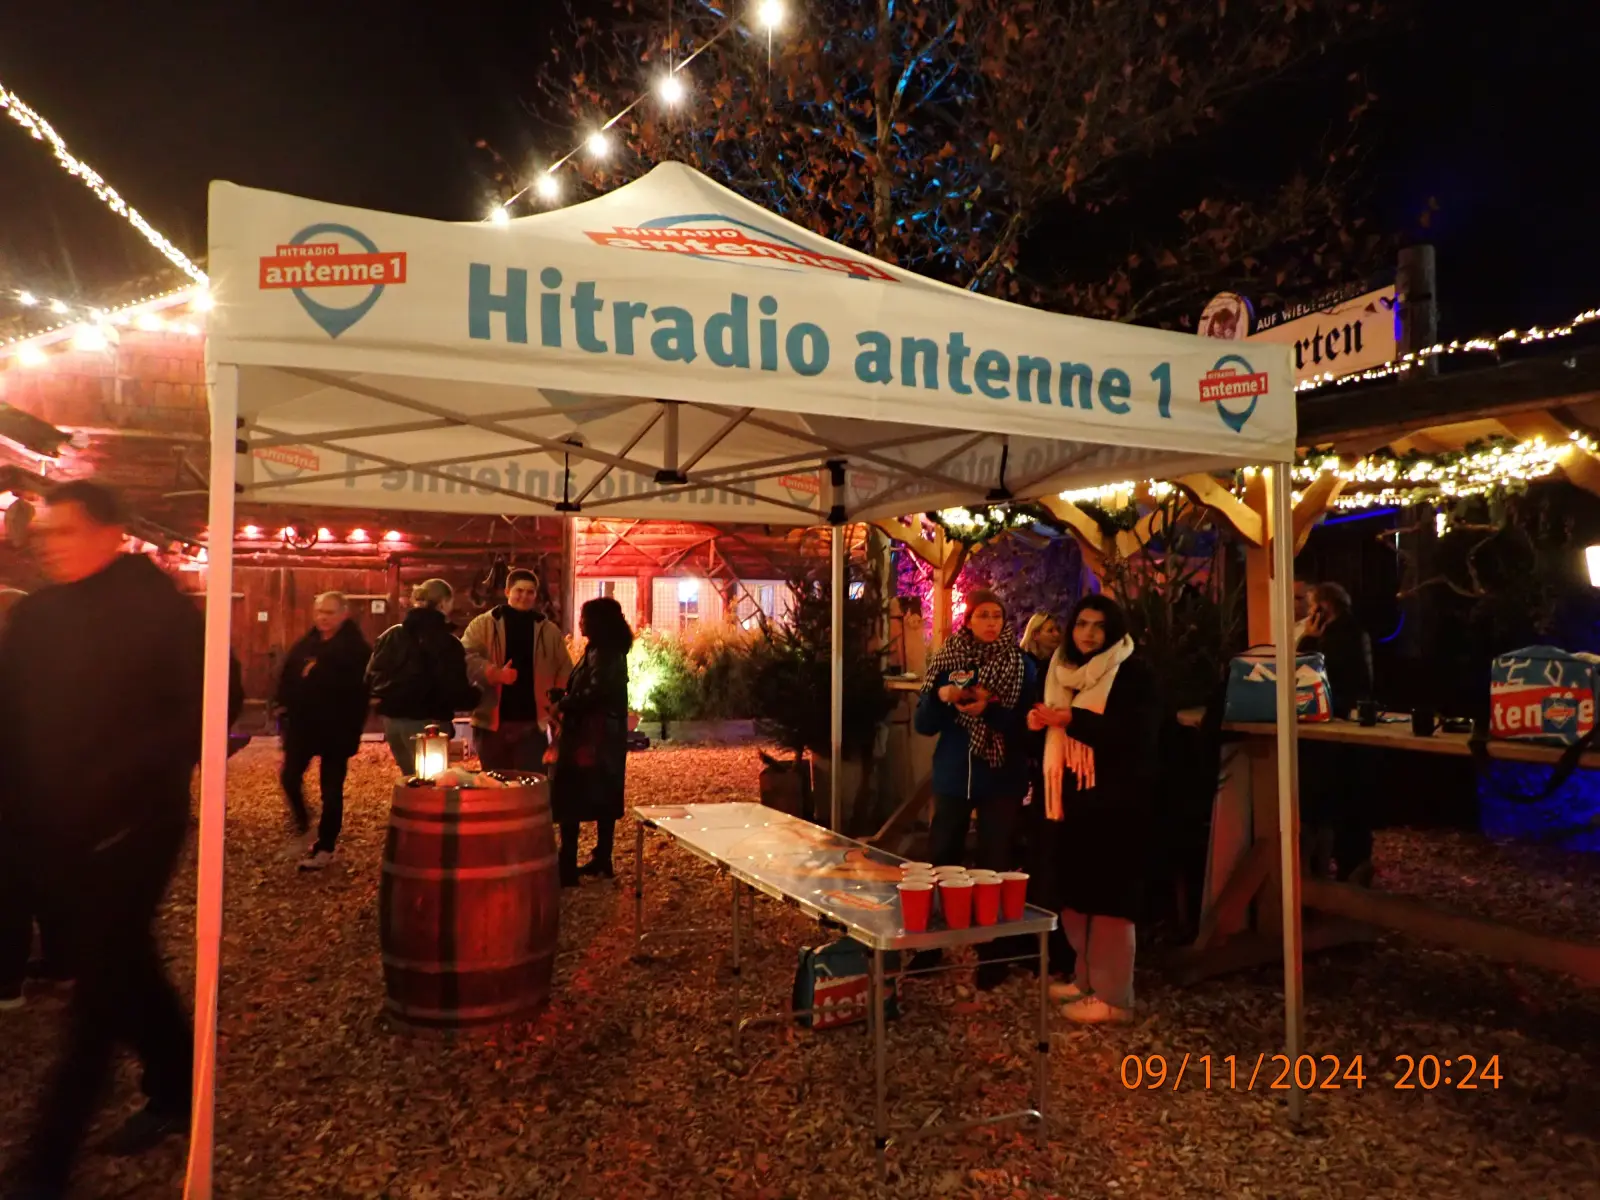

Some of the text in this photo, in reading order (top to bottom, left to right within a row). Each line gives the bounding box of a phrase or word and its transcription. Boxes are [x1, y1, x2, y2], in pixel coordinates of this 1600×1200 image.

[621, 227, 739, 238] HITRADIO
[279, 246, 337, 257] HITRADIO
[605, 236, 854, 273] antenne
[265, 257, 401, 284] antenne 1
[1256, 312, 1279, 332] AUF
[468, 262, 1172, 418] Hitradio antenne 1
[1202, 376, 1266, 399] antenne 1
